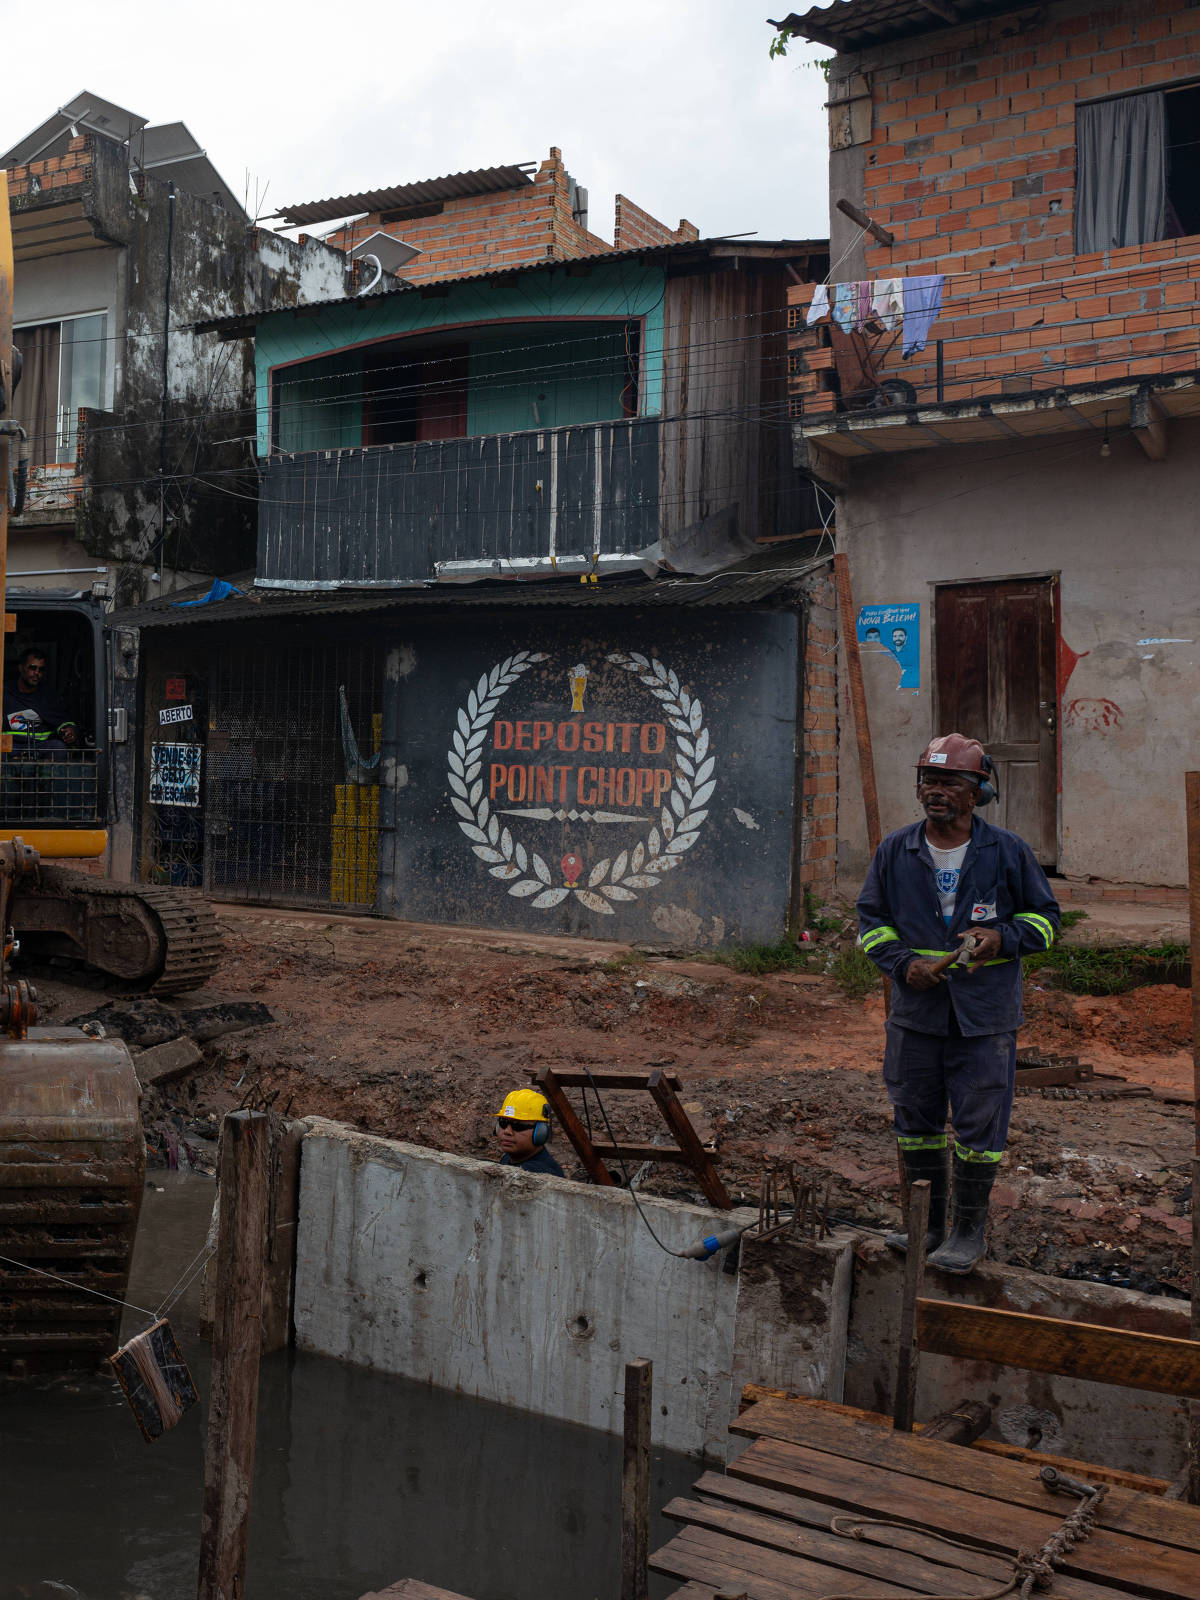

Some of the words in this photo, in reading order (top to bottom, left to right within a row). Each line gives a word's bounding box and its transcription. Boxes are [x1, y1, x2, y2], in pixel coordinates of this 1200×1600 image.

[160, 706, 193, 724] ABERTO
[489, 763, 574, 803] POINT
[577, 766, 672, 808] CHOPP
